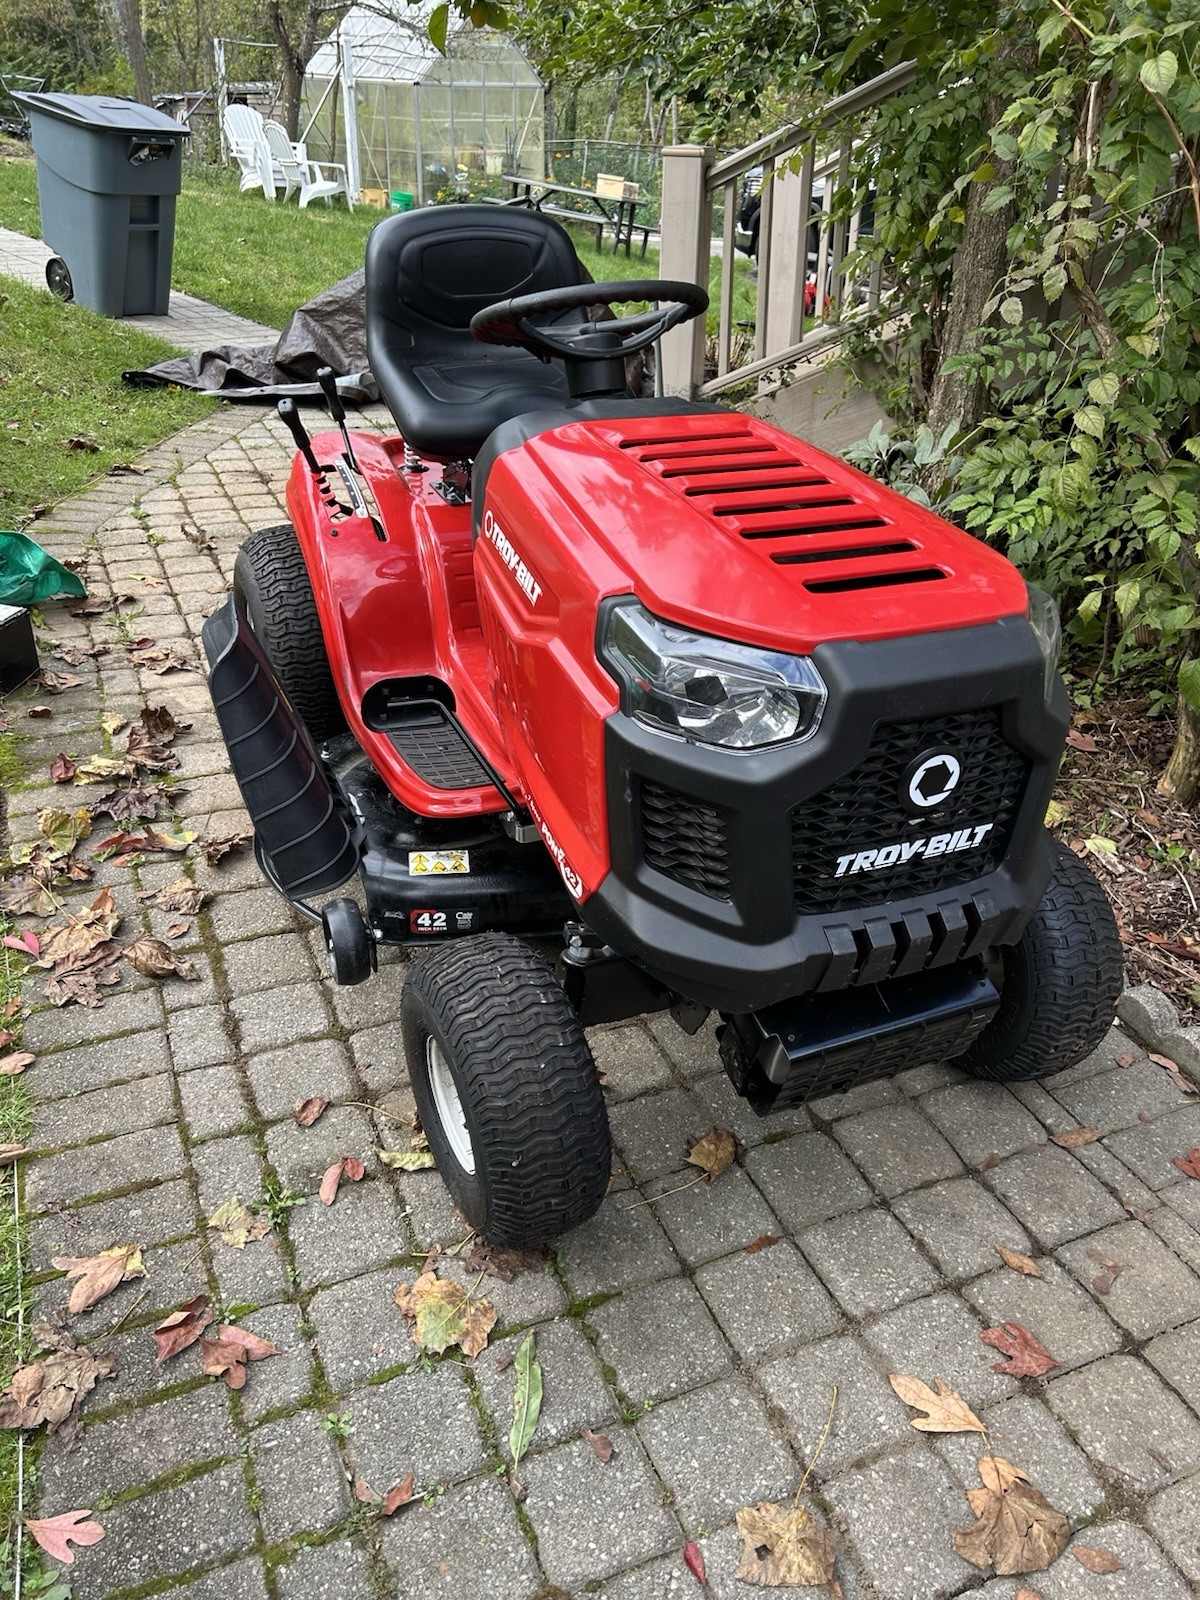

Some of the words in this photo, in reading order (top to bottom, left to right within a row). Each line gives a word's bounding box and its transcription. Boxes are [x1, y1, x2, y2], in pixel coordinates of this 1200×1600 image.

[491, 522, 543, 606] TROY-BILT
[834, 823, 993, 878] TROY-BILT
[417, 912, 447, 926] 42
